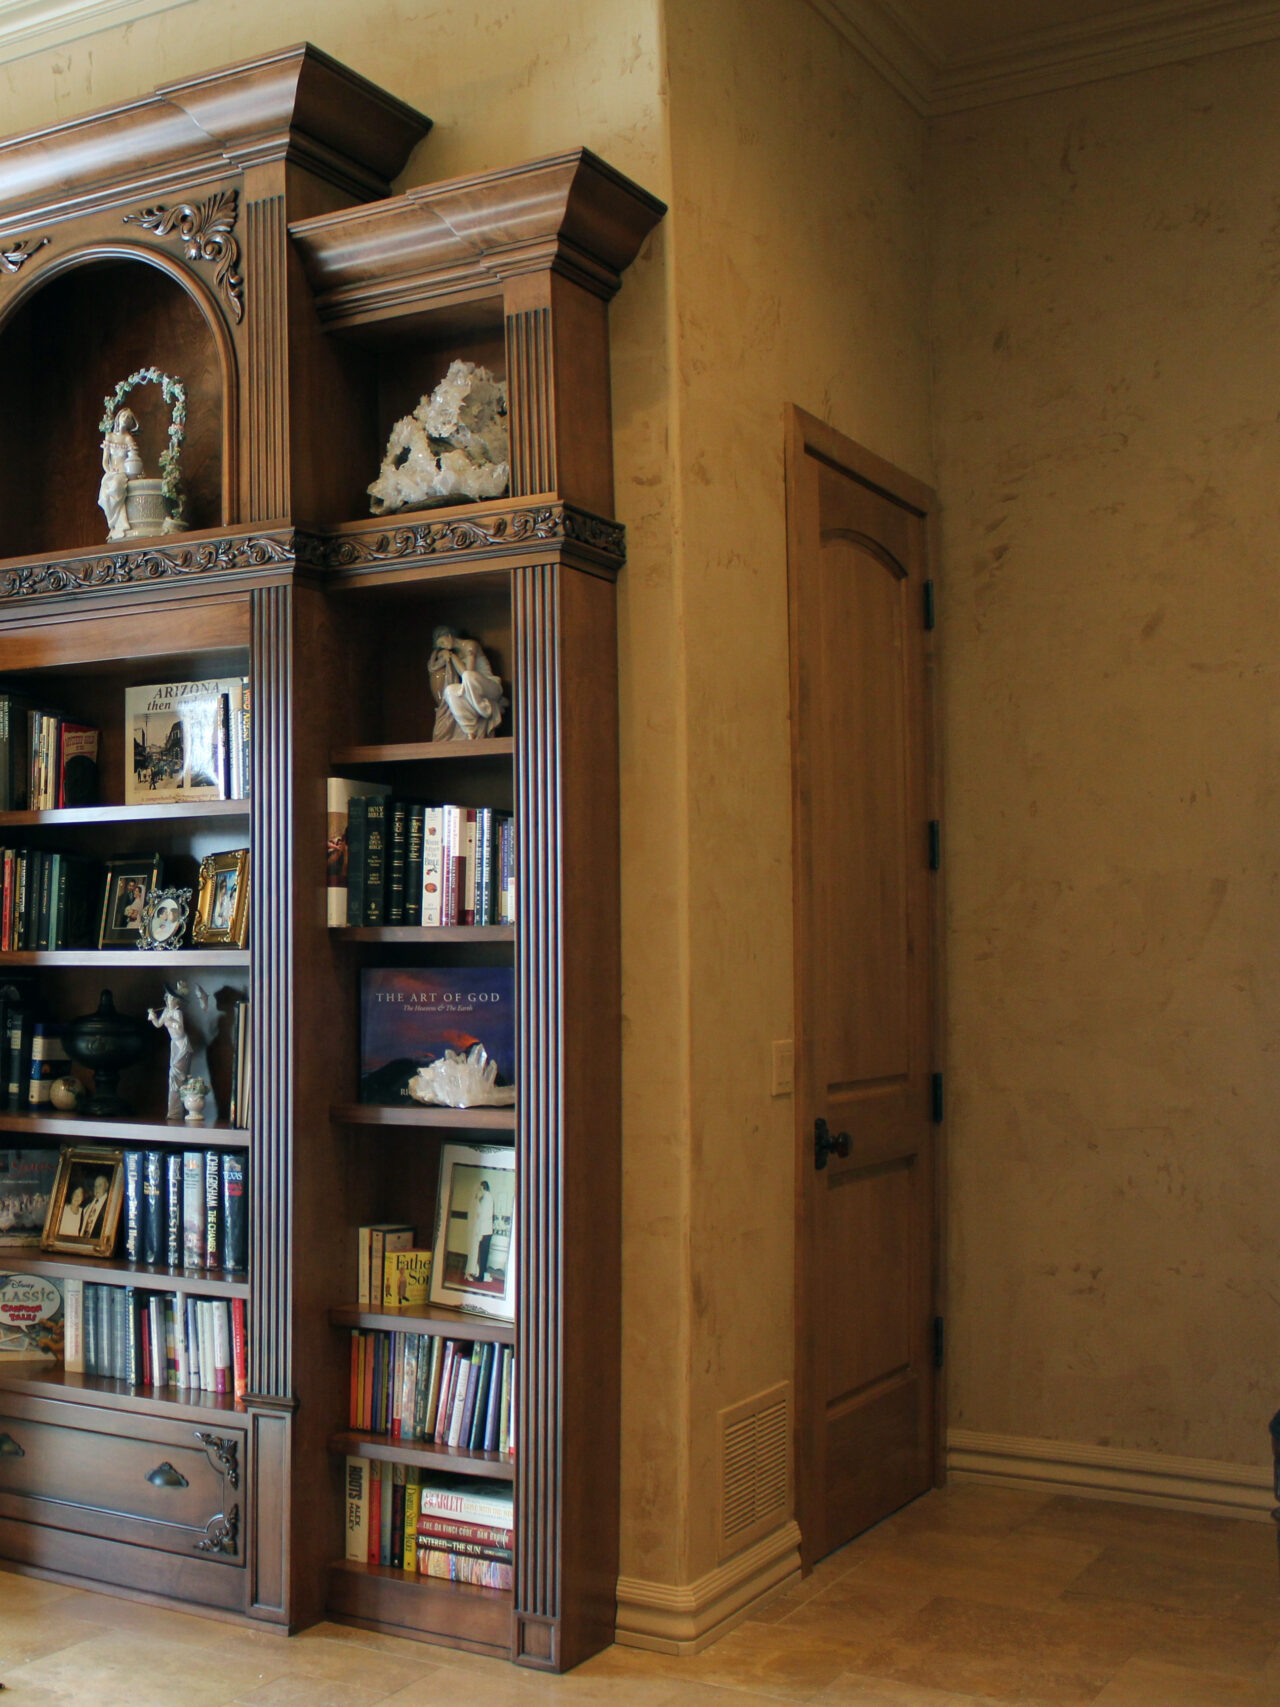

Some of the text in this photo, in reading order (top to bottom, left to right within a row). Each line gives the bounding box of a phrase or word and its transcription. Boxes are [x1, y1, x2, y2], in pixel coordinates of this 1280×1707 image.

[153, 682, 220, 699] ARIZONA
[147, 700, 171, 711] then
[376, 993, 501, 1002] THE ART OF GOD
[400, 1088, 409, 1096] RI
[129, 1154, 138, 1170] Tom
[206, 1153, 218, 1207] JOHN GRISHAM
[223, 1172, 243, 1181] TEXAS
[208, 1210, 217, 1253] THE CHAMBER
[396, 1254, 431, 1271] Fathe
[9, 1279, 35, 1290] Disney
[1, 1304, 42, 1313] CARTOON
[9, 1313, 37, 1322] TALES
[349, 1465, 362, 1500] ROOTS
[424, 1492, 464, 1513] SCARLETT
[423, 1521, 472, 1537] THE DA VINCI CODE
[476, 1531, 488, 1539] DAN
[419, 1536, 447, 1548] ENTERED
[452, 1542, 466, 1552] THE
[466, 1545, 481, 1555] SUN
